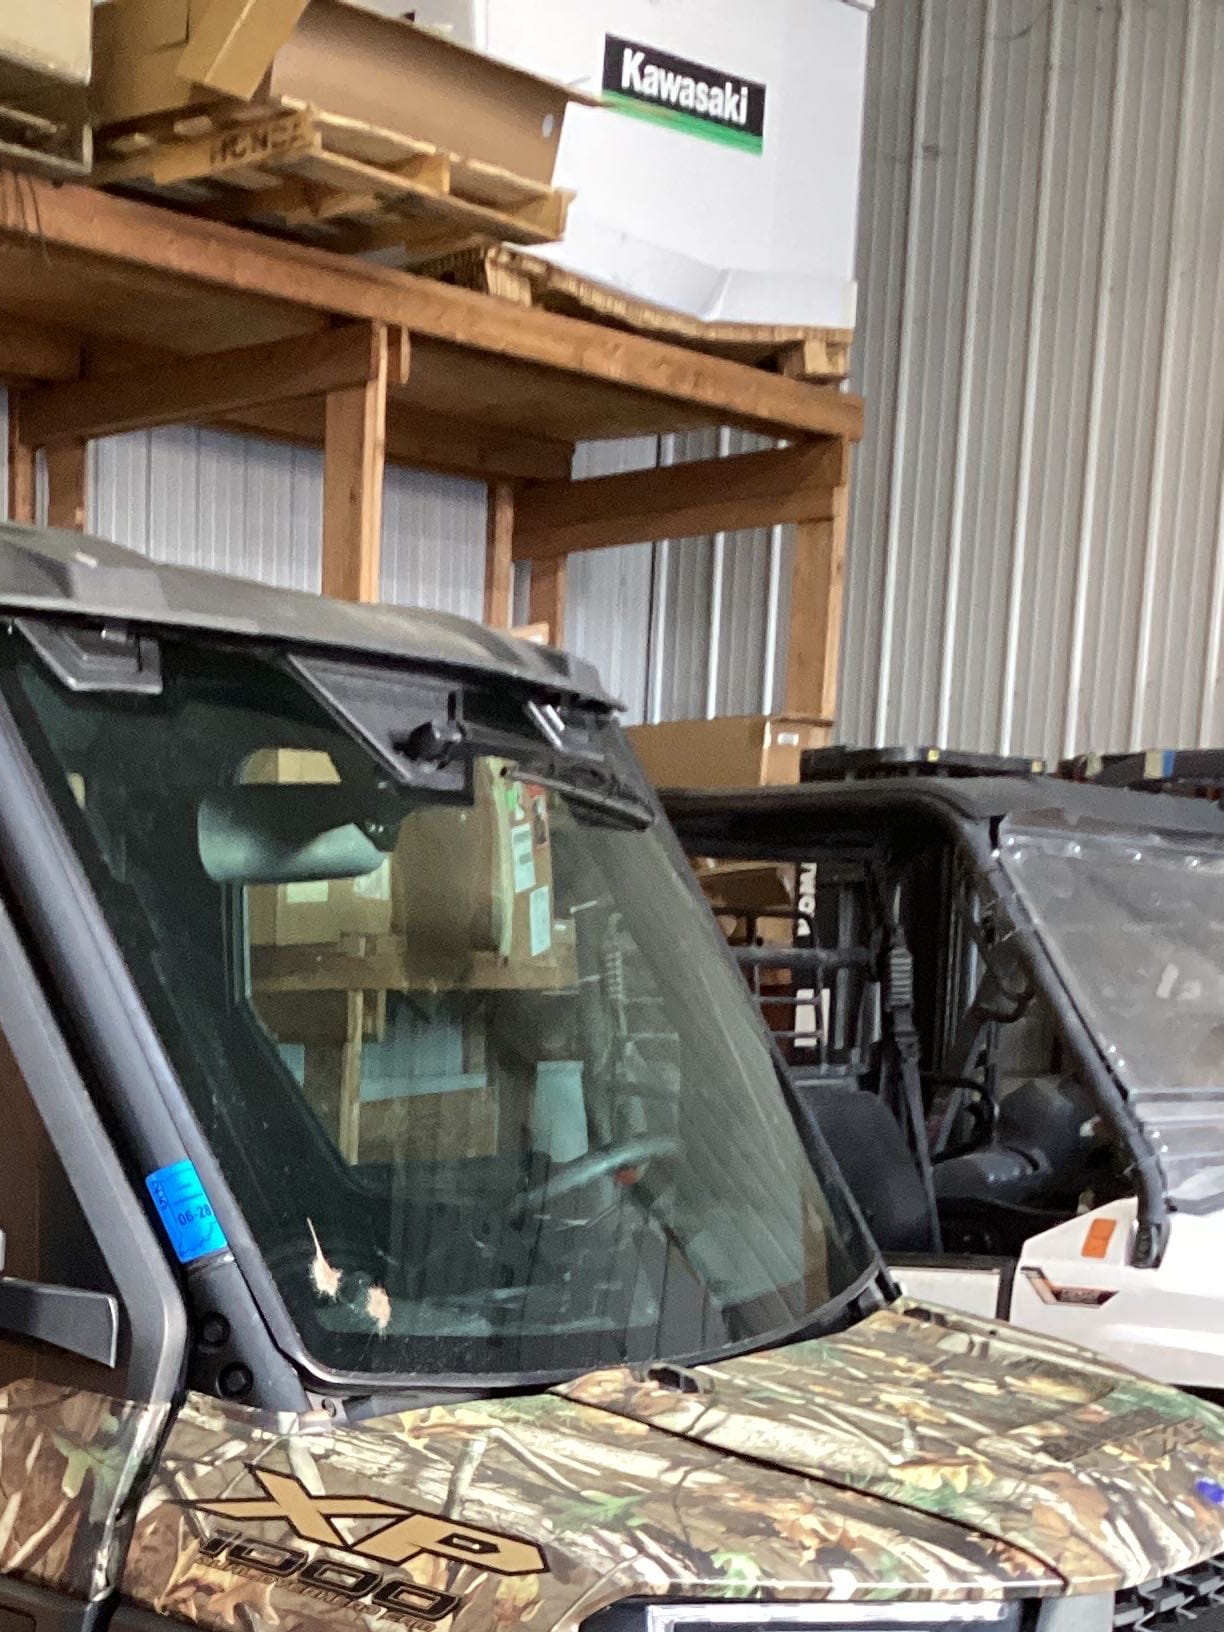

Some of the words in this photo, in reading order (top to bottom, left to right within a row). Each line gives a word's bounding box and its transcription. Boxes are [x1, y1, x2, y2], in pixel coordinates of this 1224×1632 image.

[621, 48, 748, 125] Kawasaki
[170, 1461, 551, 1577] XP
[198, 1527, 460, 1622] 1000
